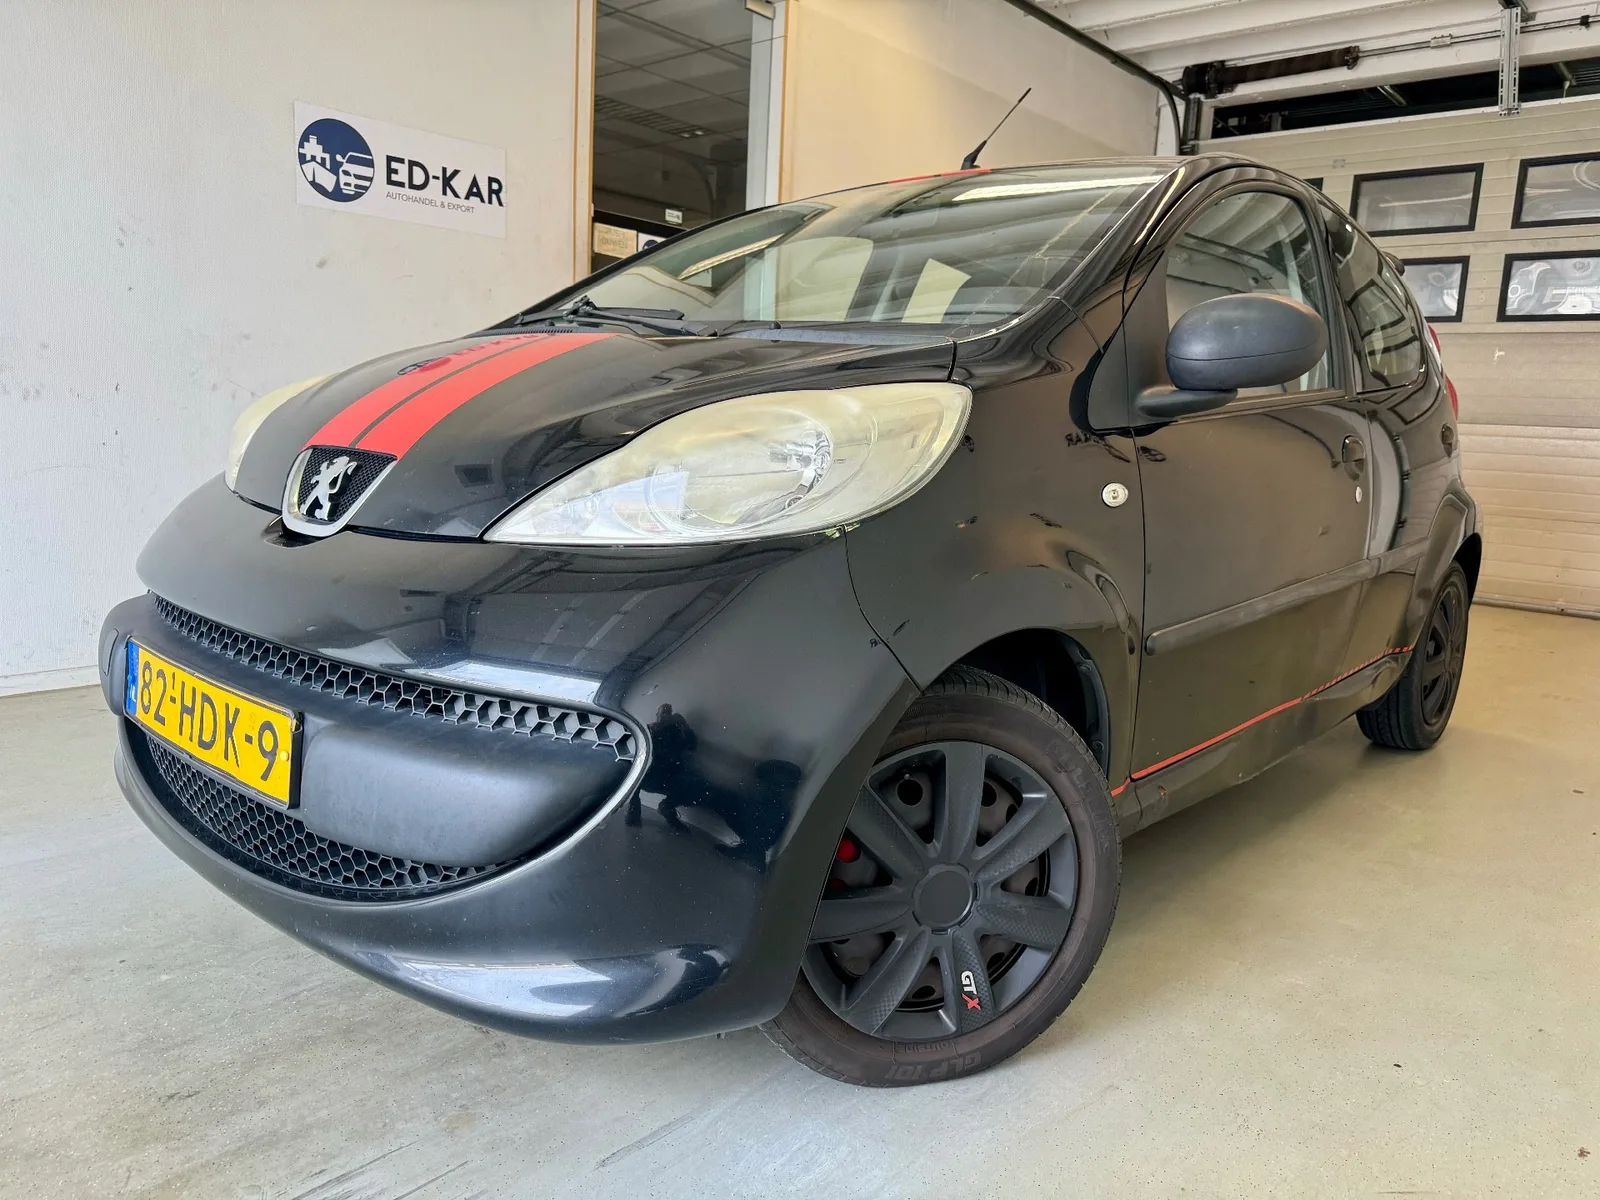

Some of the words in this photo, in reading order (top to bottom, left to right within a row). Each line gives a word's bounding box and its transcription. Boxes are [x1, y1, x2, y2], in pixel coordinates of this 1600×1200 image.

[386, 154, 504, 207] ED-KAR
[386, 191, 439, 208] AUTOHANDEL
[440, 200, 446, 209] &
[447, 202, 475, 214] EXPORT
[140, 660, 279, 782] 82-HDK-9
[960, 970, 982, 1011] GTX
